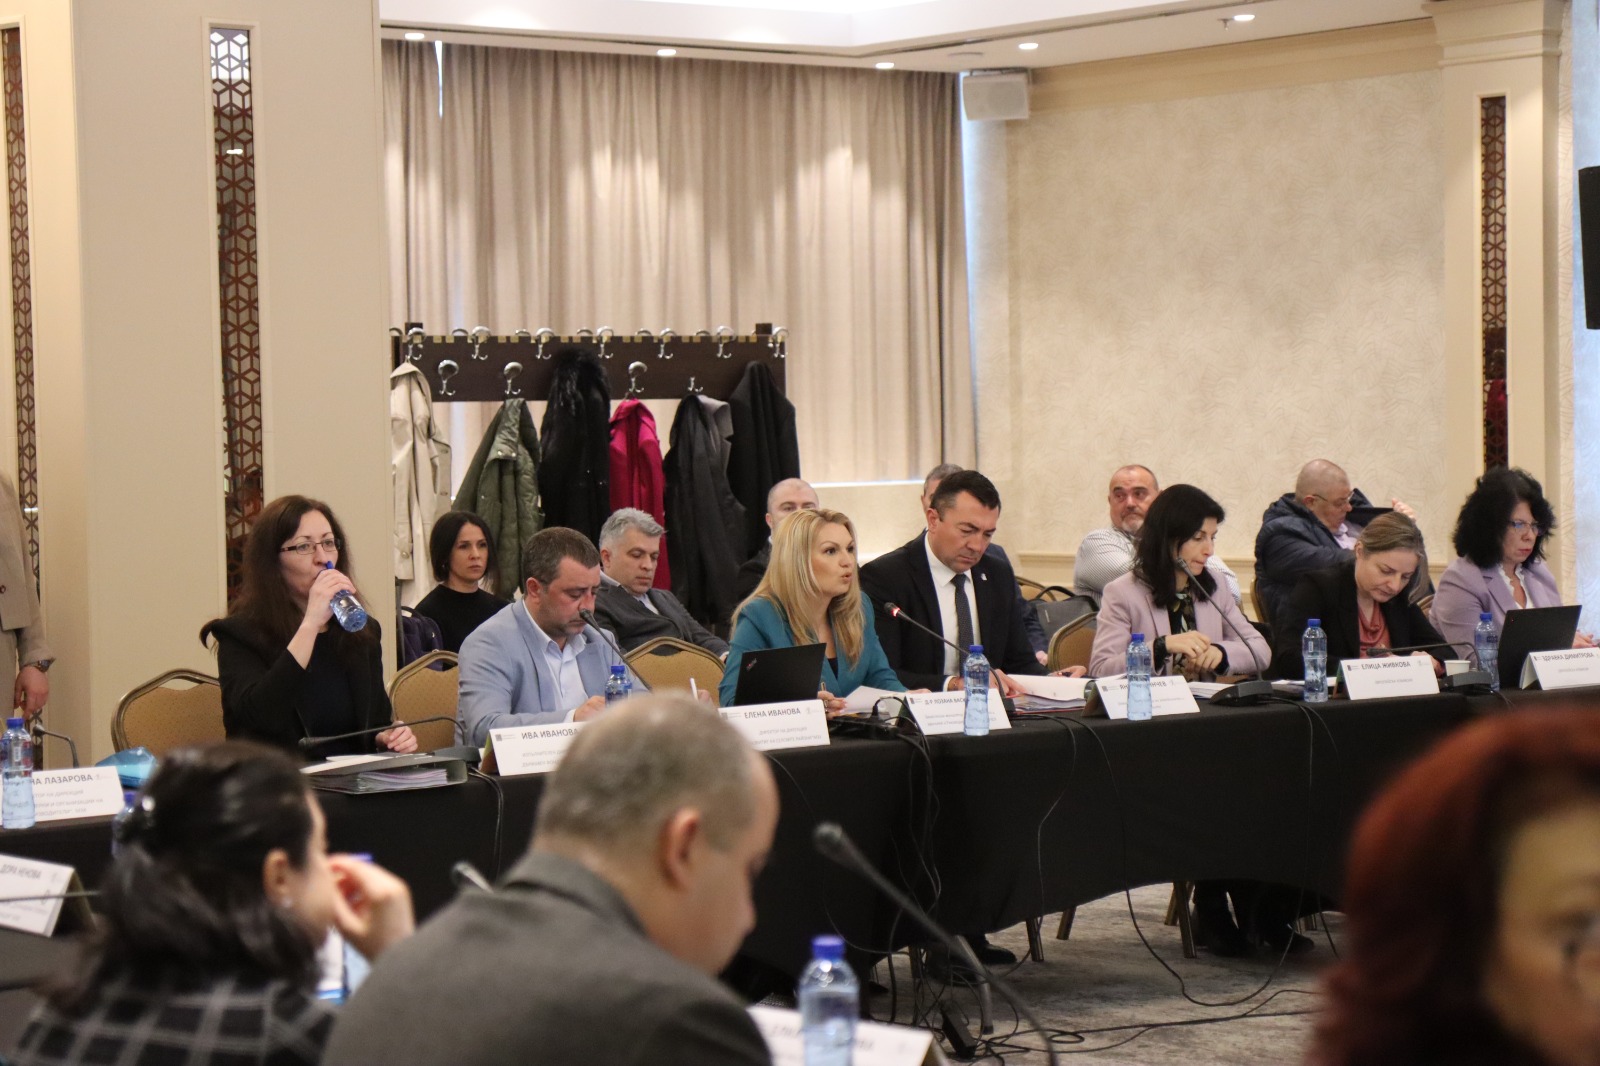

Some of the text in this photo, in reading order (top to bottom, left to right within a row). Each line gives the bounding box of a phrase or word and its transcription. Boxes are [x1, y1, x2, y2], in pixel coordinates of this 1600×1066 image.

[1361, 662, 1382, 670] ЕЛИЦА
[744, 709, 768, 719] ЕЛЕНА
[768, 707, 801, 717] ИВАНОВА
[521, 731, 539, 740] ИВА
[540, 728, 578, 739] ИВАНОВА
[45, 774, 93, 785] ЛАЗАРОВА
